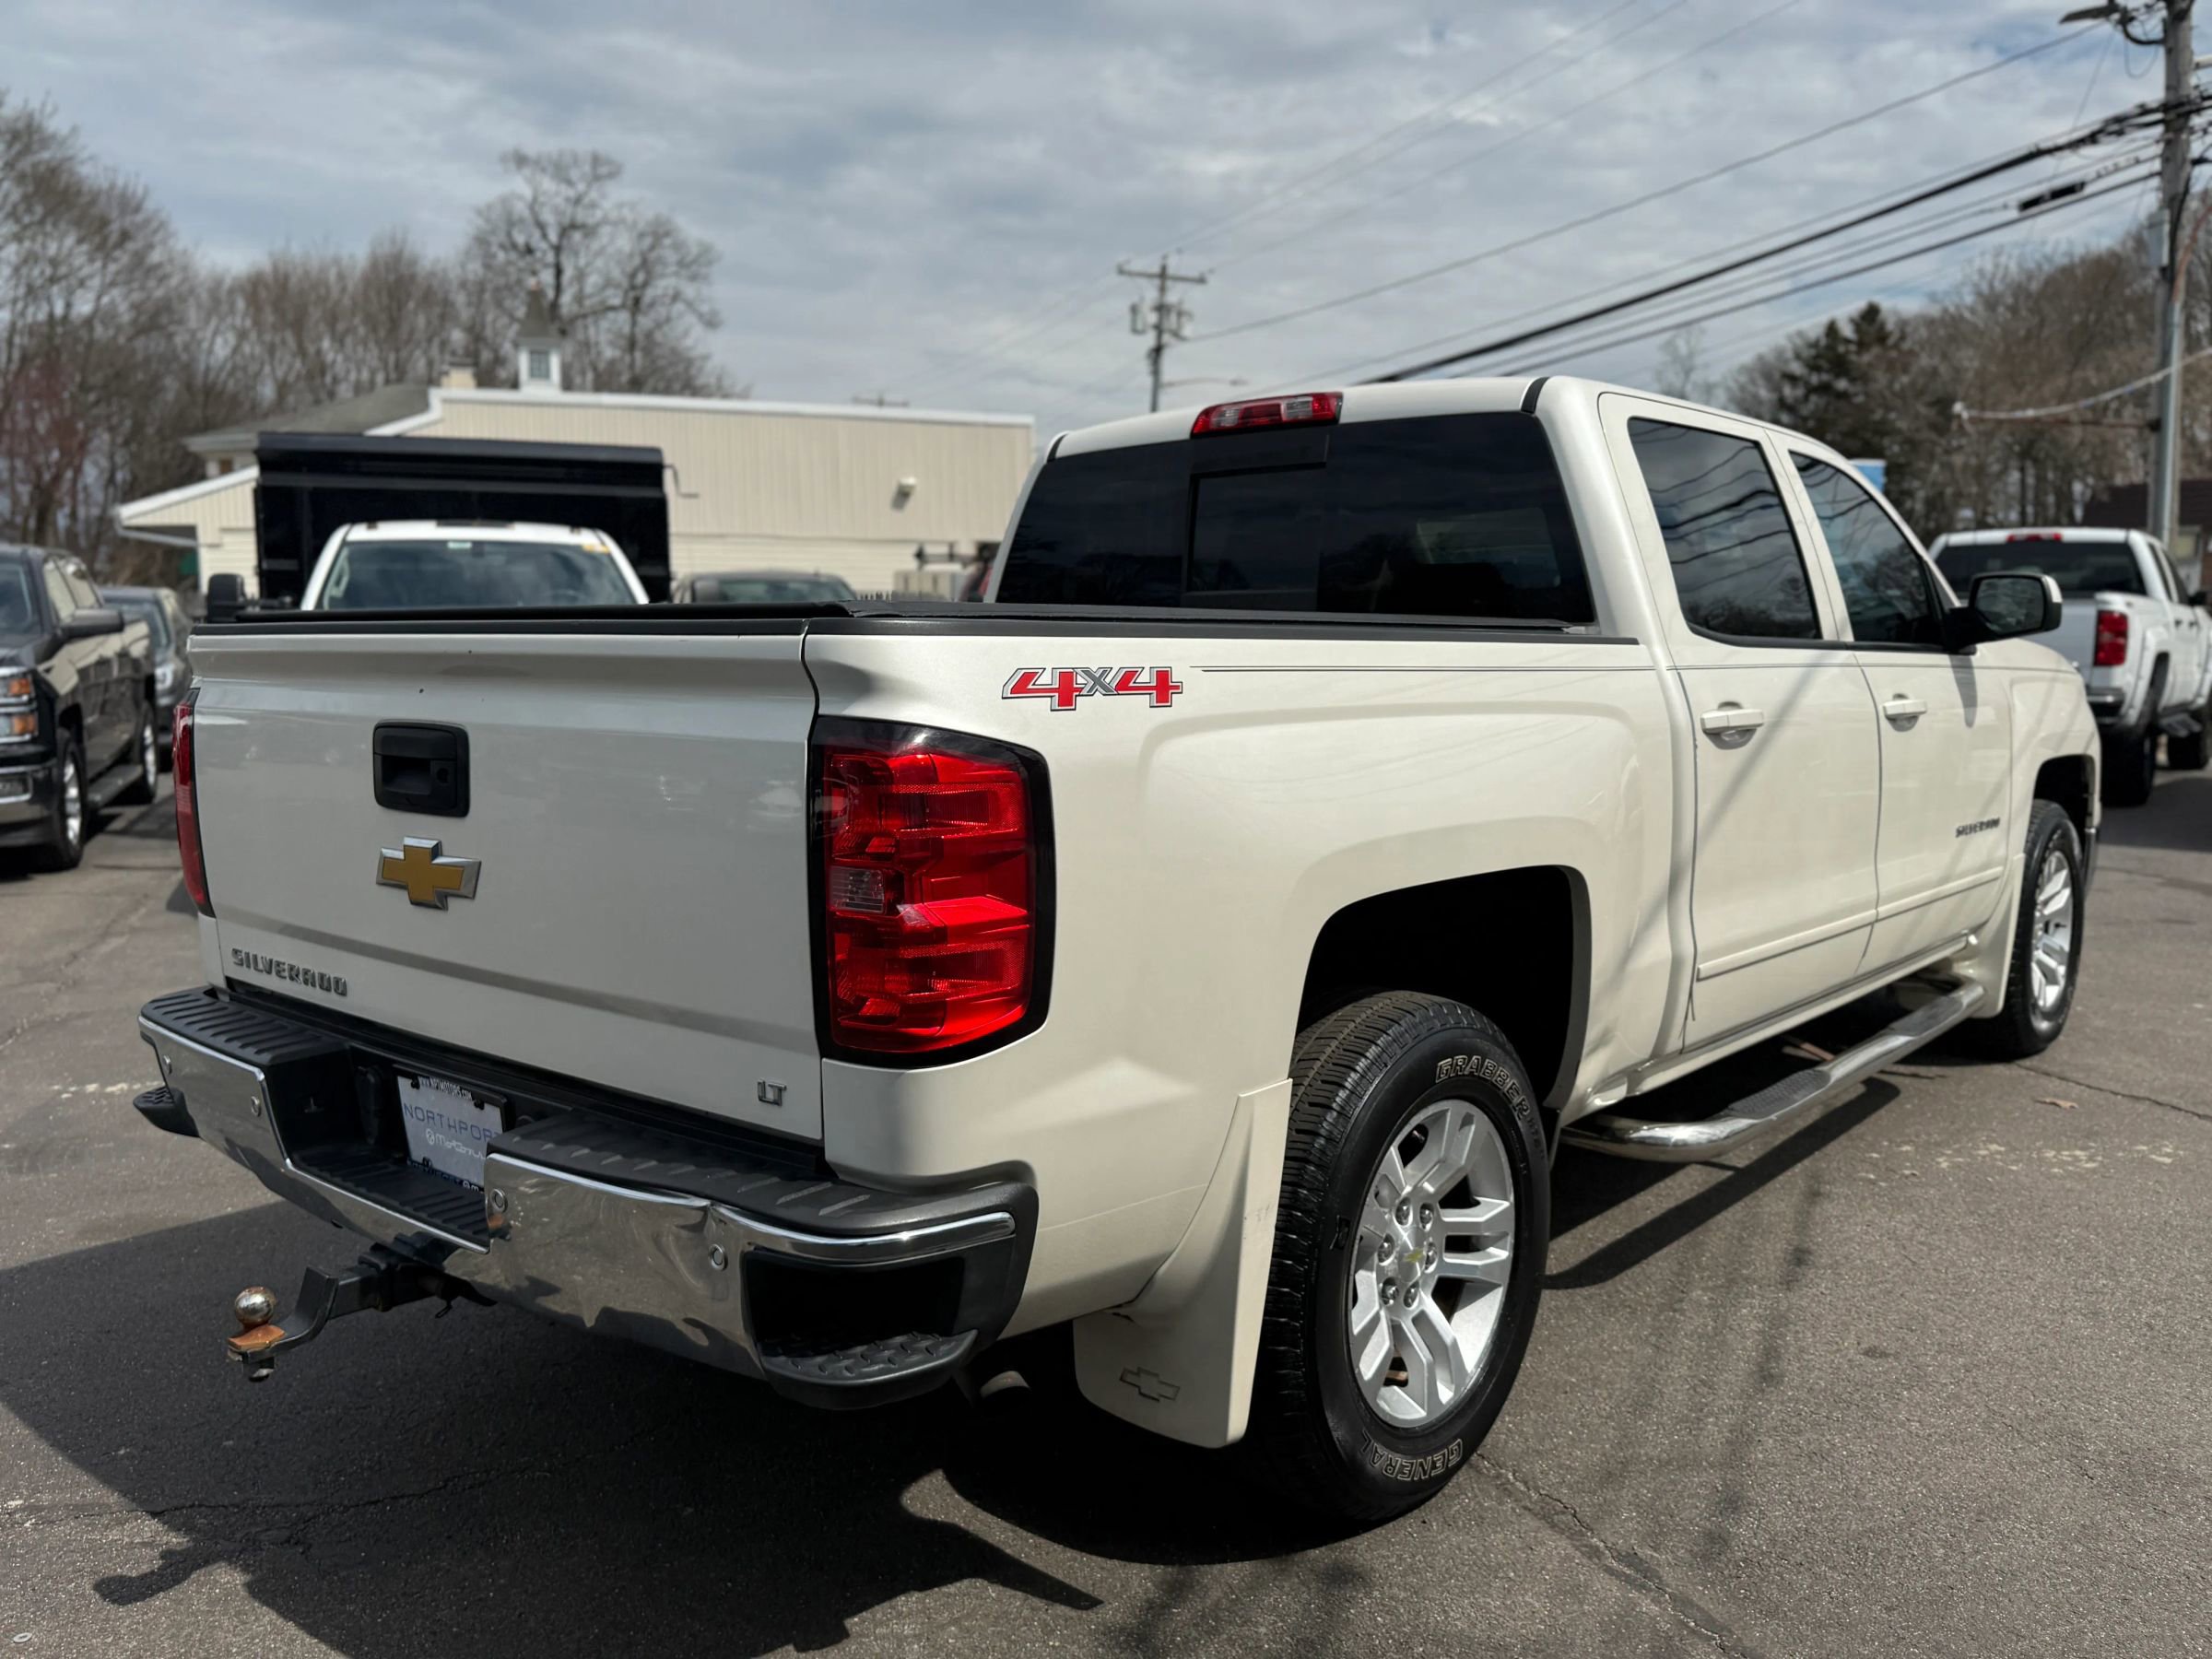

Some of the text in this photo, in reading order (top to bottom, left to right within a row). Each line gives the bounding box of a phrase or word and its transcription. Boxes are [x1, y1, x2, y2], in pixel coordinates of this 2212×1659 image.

[231, 947, 347, 997] SILVERADO
[757, 1078, 787, 1108] LT
[1435, 1054, 1531, 1121] GRABBER
[1360, 1427, 1464, 1481] GENERAL
